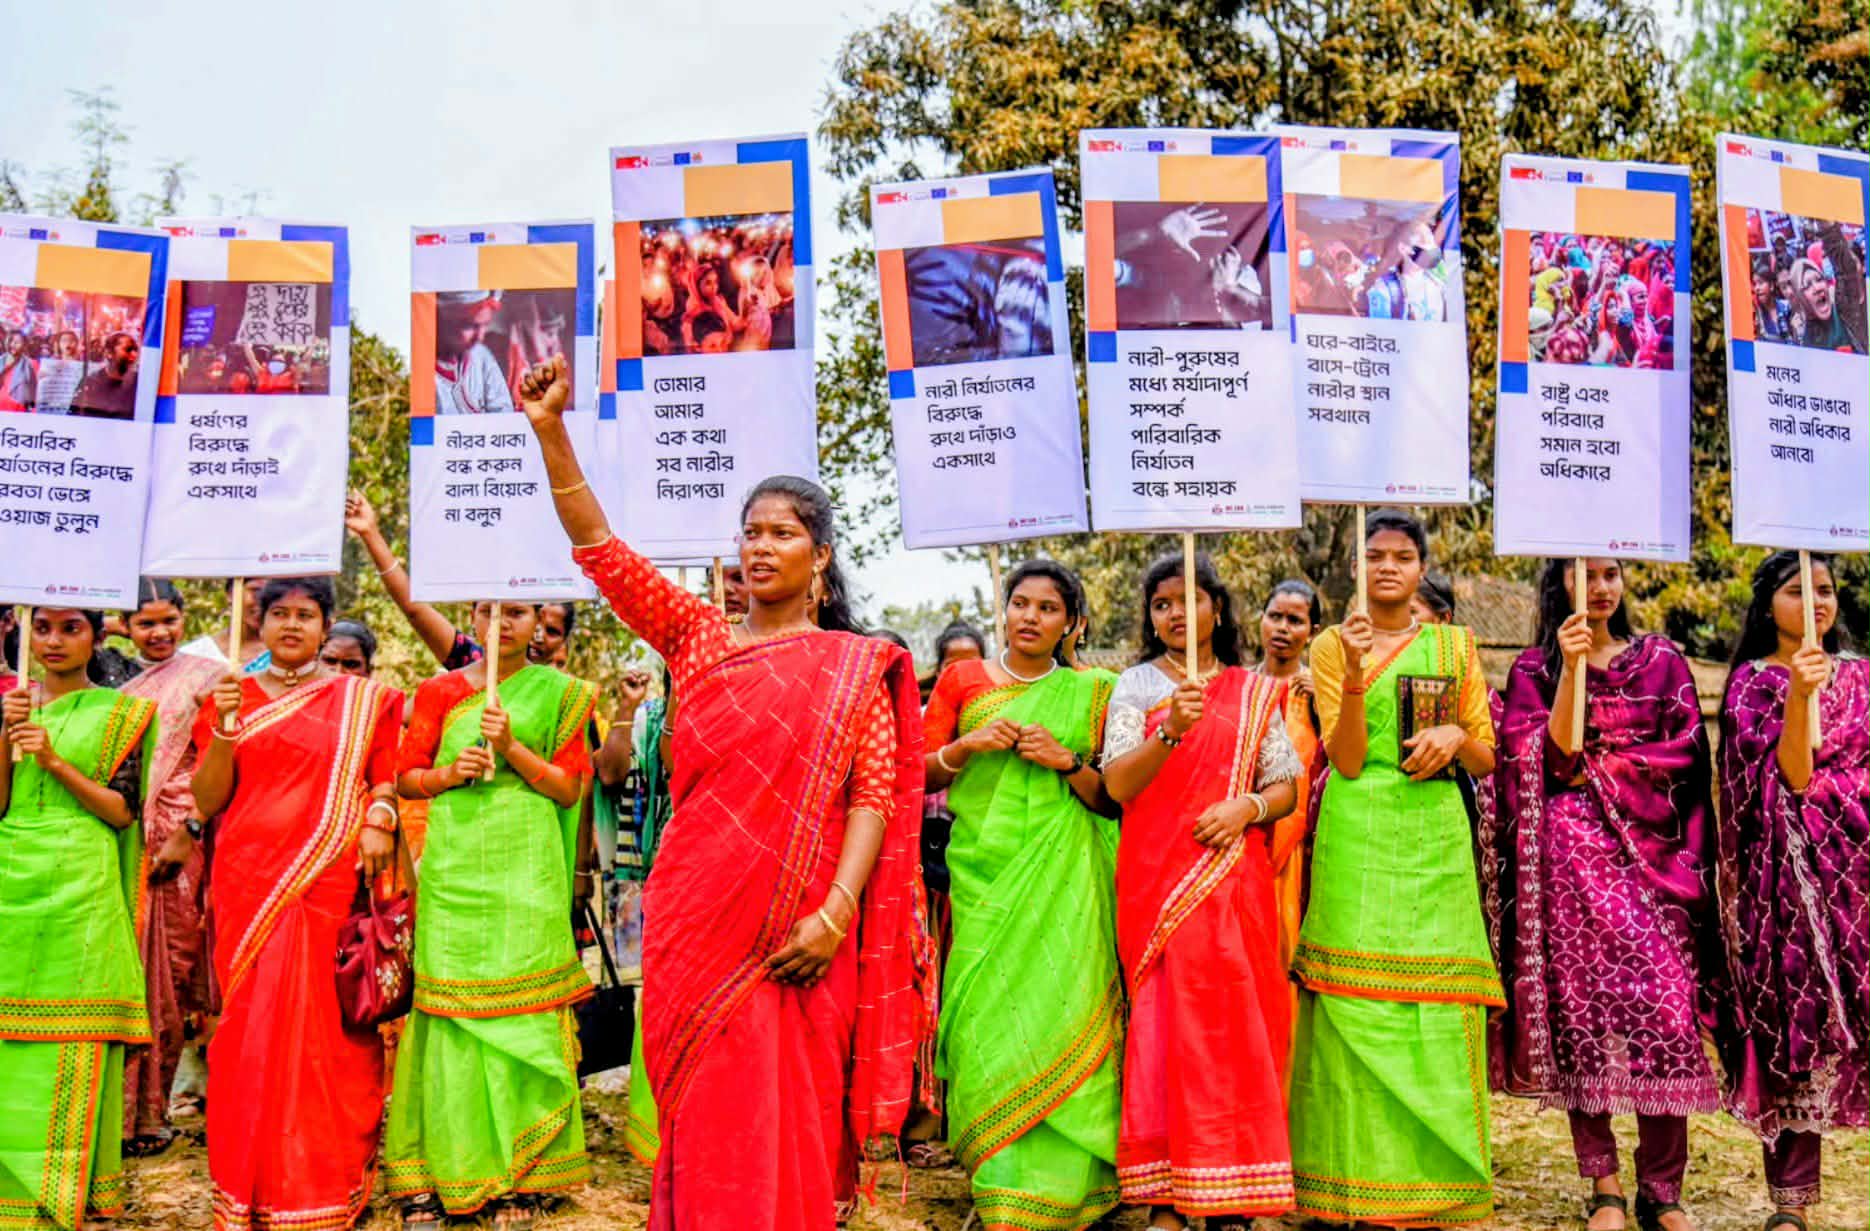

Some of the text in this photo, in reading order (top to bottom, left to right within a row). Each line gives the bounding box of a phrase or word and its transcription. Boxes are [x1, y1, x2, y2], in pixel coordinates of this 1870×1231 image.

[1127, 346, 1240, 373] নারী-পুরুষের
[1307, 356, 1390, 378] বাসে-ট্রেনে
[653, 376, 706, 394] তোমার
[1128, 371, 1250, 399] মধ্যে মর্যাদাপূর্ণ
[1766, 365, 1801, 384] মনের
[925, 375, 1035, 399] নারী নির্যাতনের
[1307, 379, 1390, 401] নারীর স্থান
[1541, 382, 1610, 405] রাষ্ট্র এবং
[654, 403, 704, 420] আমার
[1129, 397, 1187, 418] সম্পর্ক
[1768, 388, 1851, 416] আঁধার ভাঙবো
[190, 409, 248, 429] ধর্ষণের
[927, 404, 983, 423] বিরুদ্ধে
[1541, 406, 1605, 430] পরিবারে
[0, 427, 77, 450] রিবারিক
[655, 428, 727, 446] এক কথা
[968, 424, 1017, 443] দাঁড়াও
[1130, 423, 1222, 445] পারিবারিক
[1769, 414, 1851, 442] নারী অধিকার
[189, 433, 250, 452] বিরুদ্ধে
[446, 430, 526, 450] নীরব থাকা
[1540, 437, 1620, 455] সমান হবো
[656, 450, 734, 473] সব নারীর
[932, 451, 996, 470] একসাথে
[1131, 449, 1194, 470] নির্যাতন
[1770, 444, 1814, 463] আনবো
[0, 454, 134, 482] র্যাতনের বিরুদ্ধে
[231, 457, 280, 478] দাঁড়াই
[446, 458, 522, 474] বন্ধ করুন
[1540, 457, 1611, 482] অধিকারে
[0, 483, 43, 499] রবতা
[187, 485, 257, 499] একসাথে
[445, 477, 538, 498] বাল্য বিয়েকে
[656, 478, 725, 500] নিরাপত্তা
[1132, 481, 1237, 498] বন্ধে সহায়ক
[0, 509, 100, 534] ওয়াজ তুলুন
[445, 507, 501, 527] না বলুন
